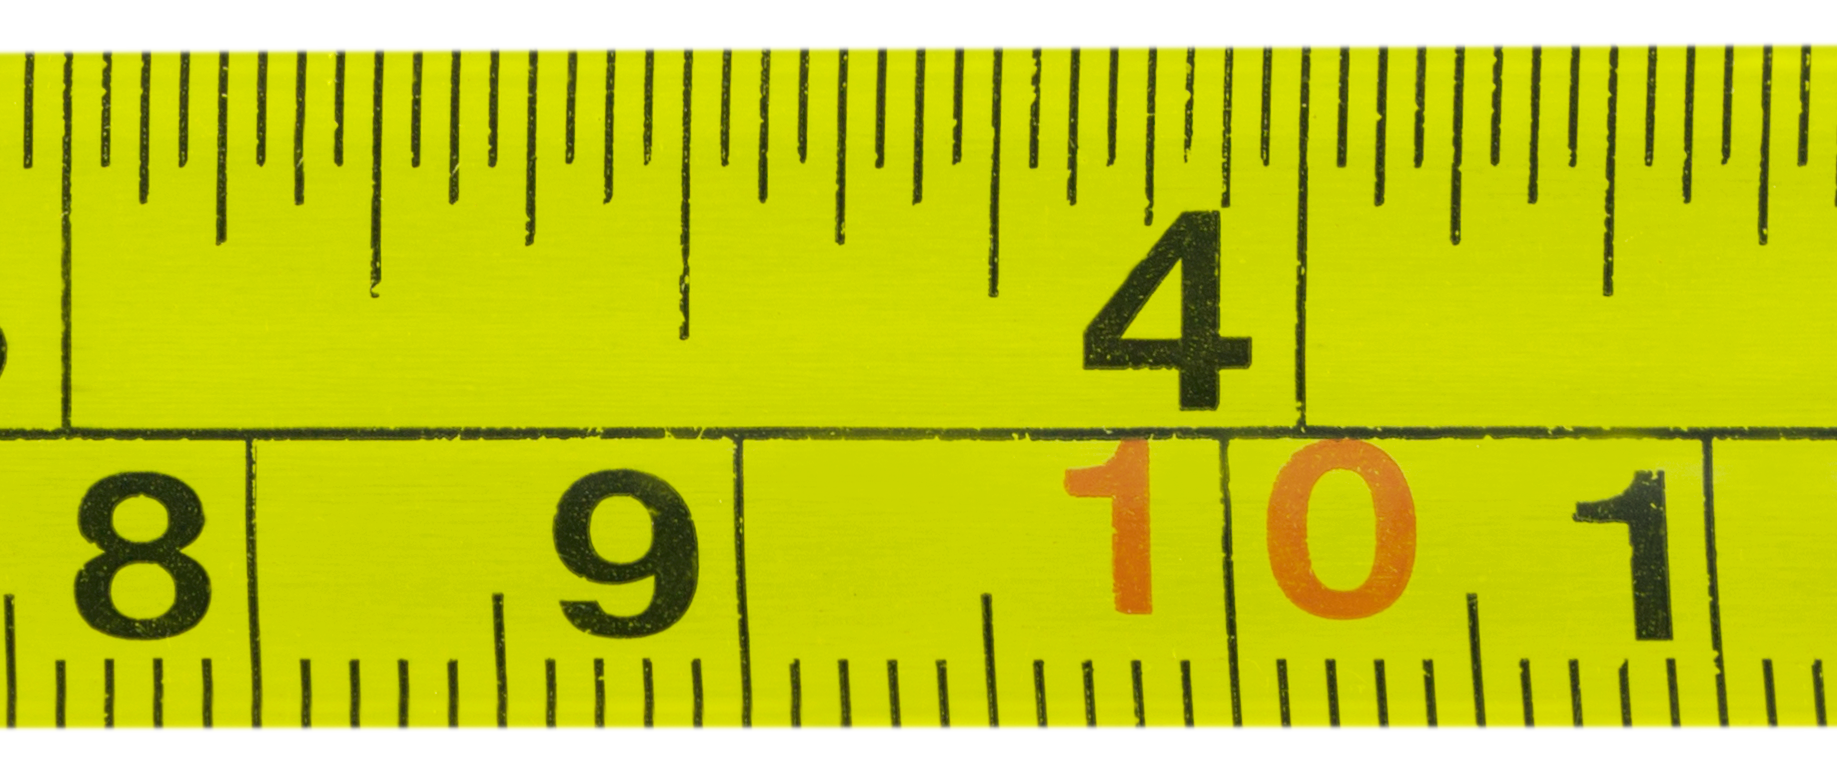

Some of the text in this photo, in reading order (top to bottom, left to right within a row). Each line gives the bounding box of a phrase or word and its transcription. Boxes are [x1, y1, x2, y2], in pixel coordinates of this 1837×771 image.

[1083, 210, 1252, 411] 4
[73, 471, 212, 641] 8
[552, 469, 700, 639] 9
[1571, 470, 1674, 641] 1
